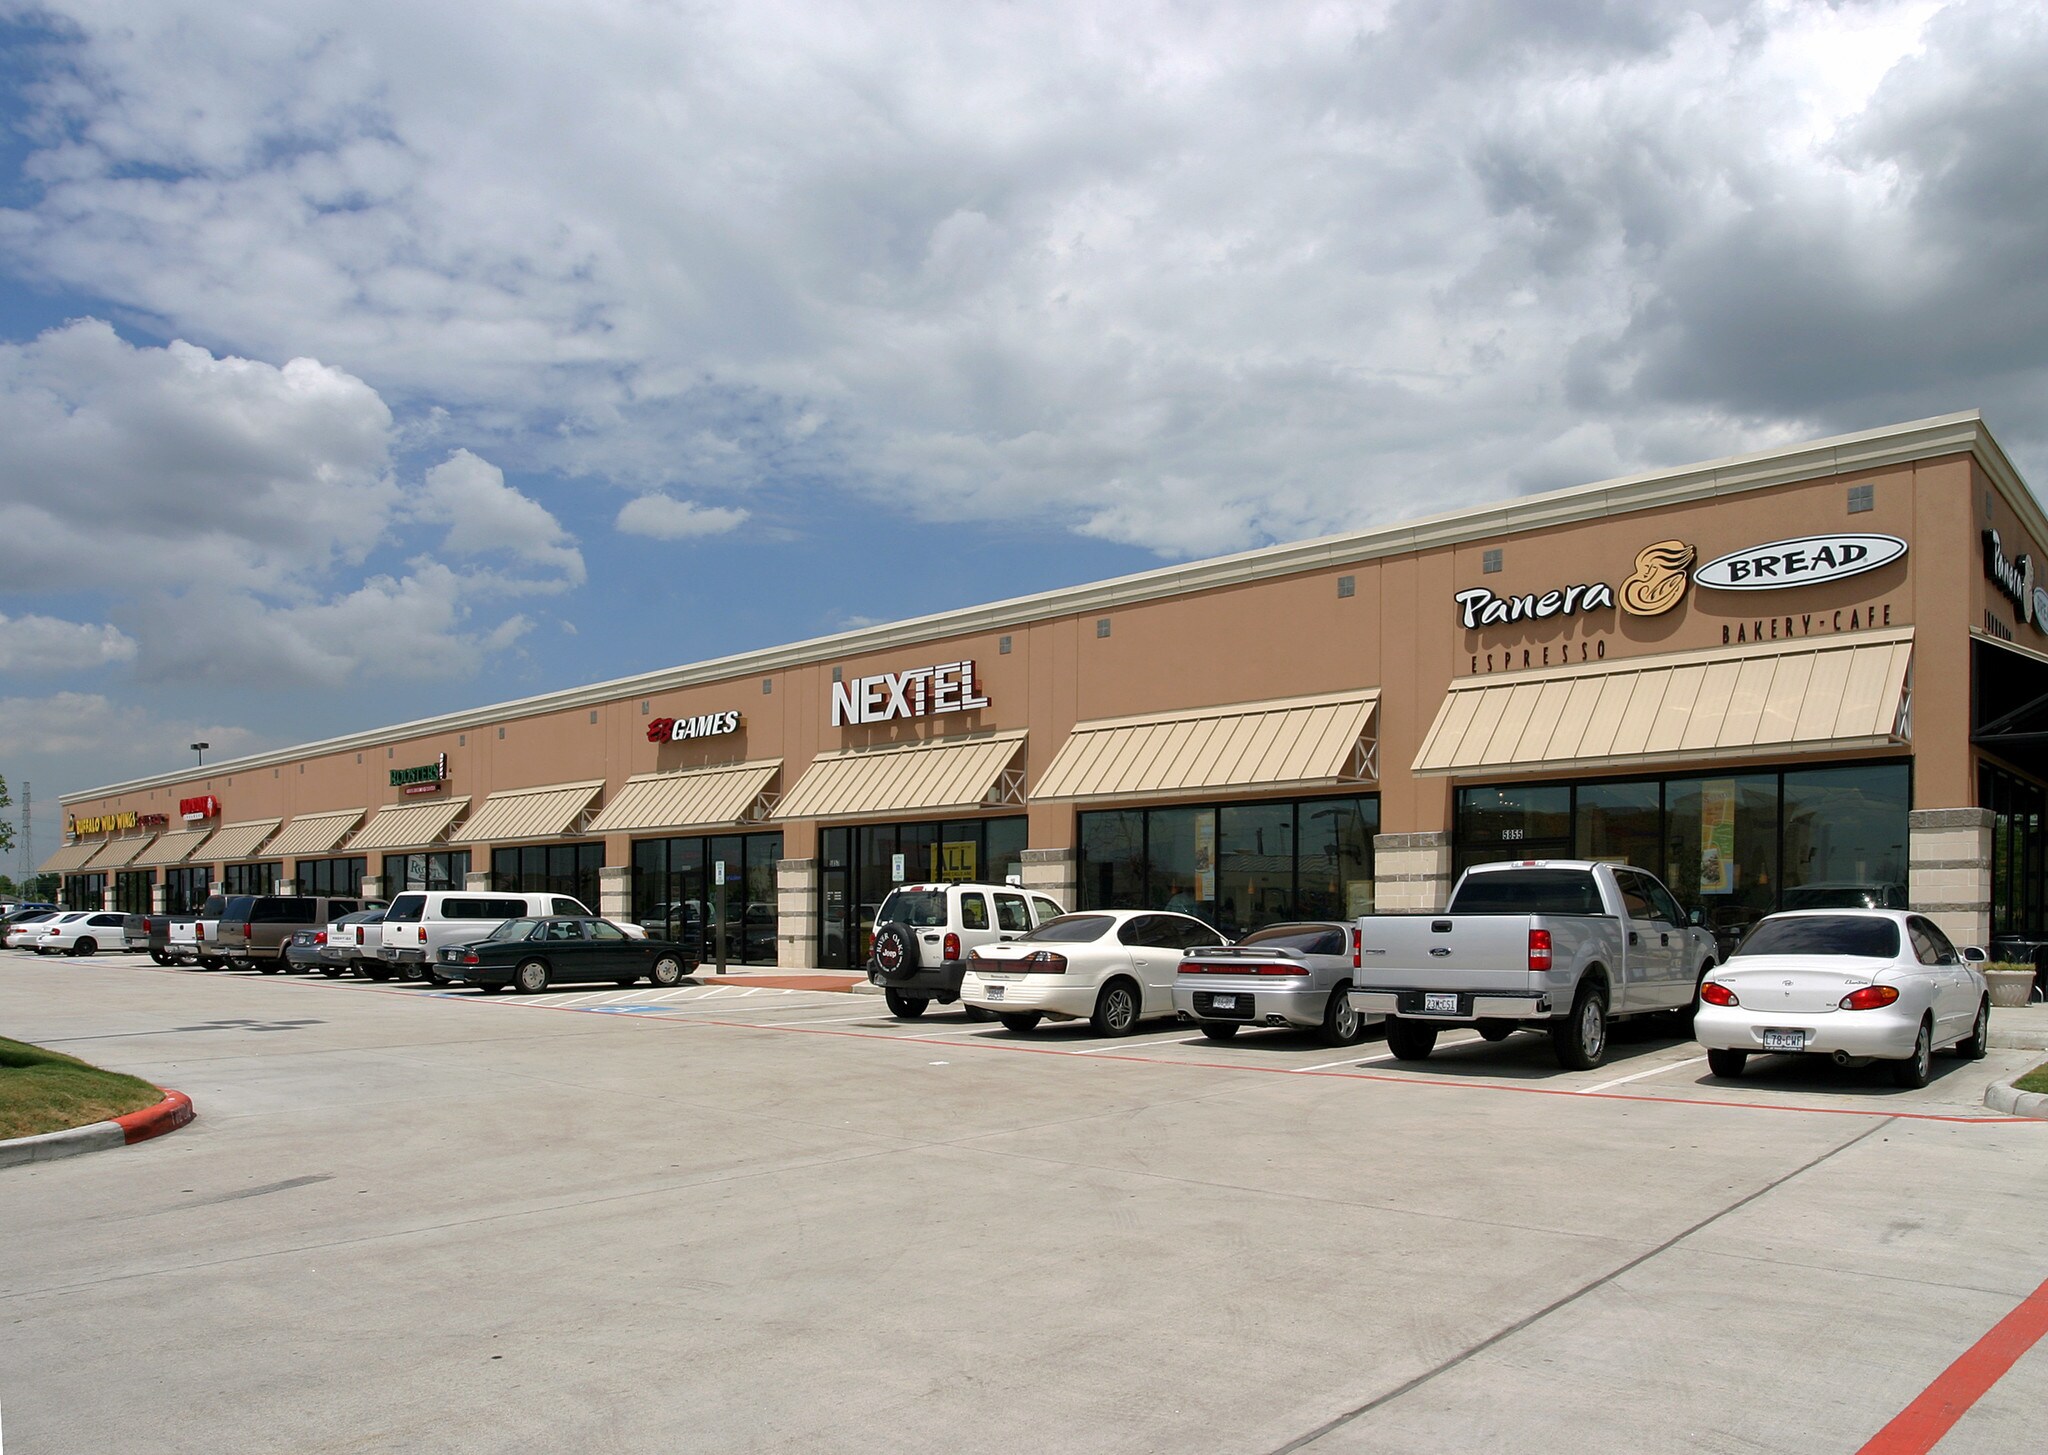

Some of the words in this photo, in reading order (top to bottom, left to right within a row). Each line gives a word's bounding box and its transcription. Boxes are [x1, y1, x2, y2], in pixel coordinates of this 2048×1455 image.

[1727, 544, 1868, 582] BREAD
[1455, 582, 1616, 629] Panera
[1722, 604, 1891, 645] BAKERY-CAFE
[1471, 639, 1606, 674] ESPRESSO
[831, 660, 990, 727] NEXTEL
[646, 717, 674, 744] EB
[671, 710, 741, 741] GAMES
[76, 816, 100, 835] BUFFALO
[101, 814, 116, 832] WILD
[116, 811, 138, 829] WINGS
[1502, 829, 1524, 840] 5855
[876, 932, 890, 953] RIVER
[892, 933, 904, 956] OAKS
[882, 948, 897, 958] Jeep
